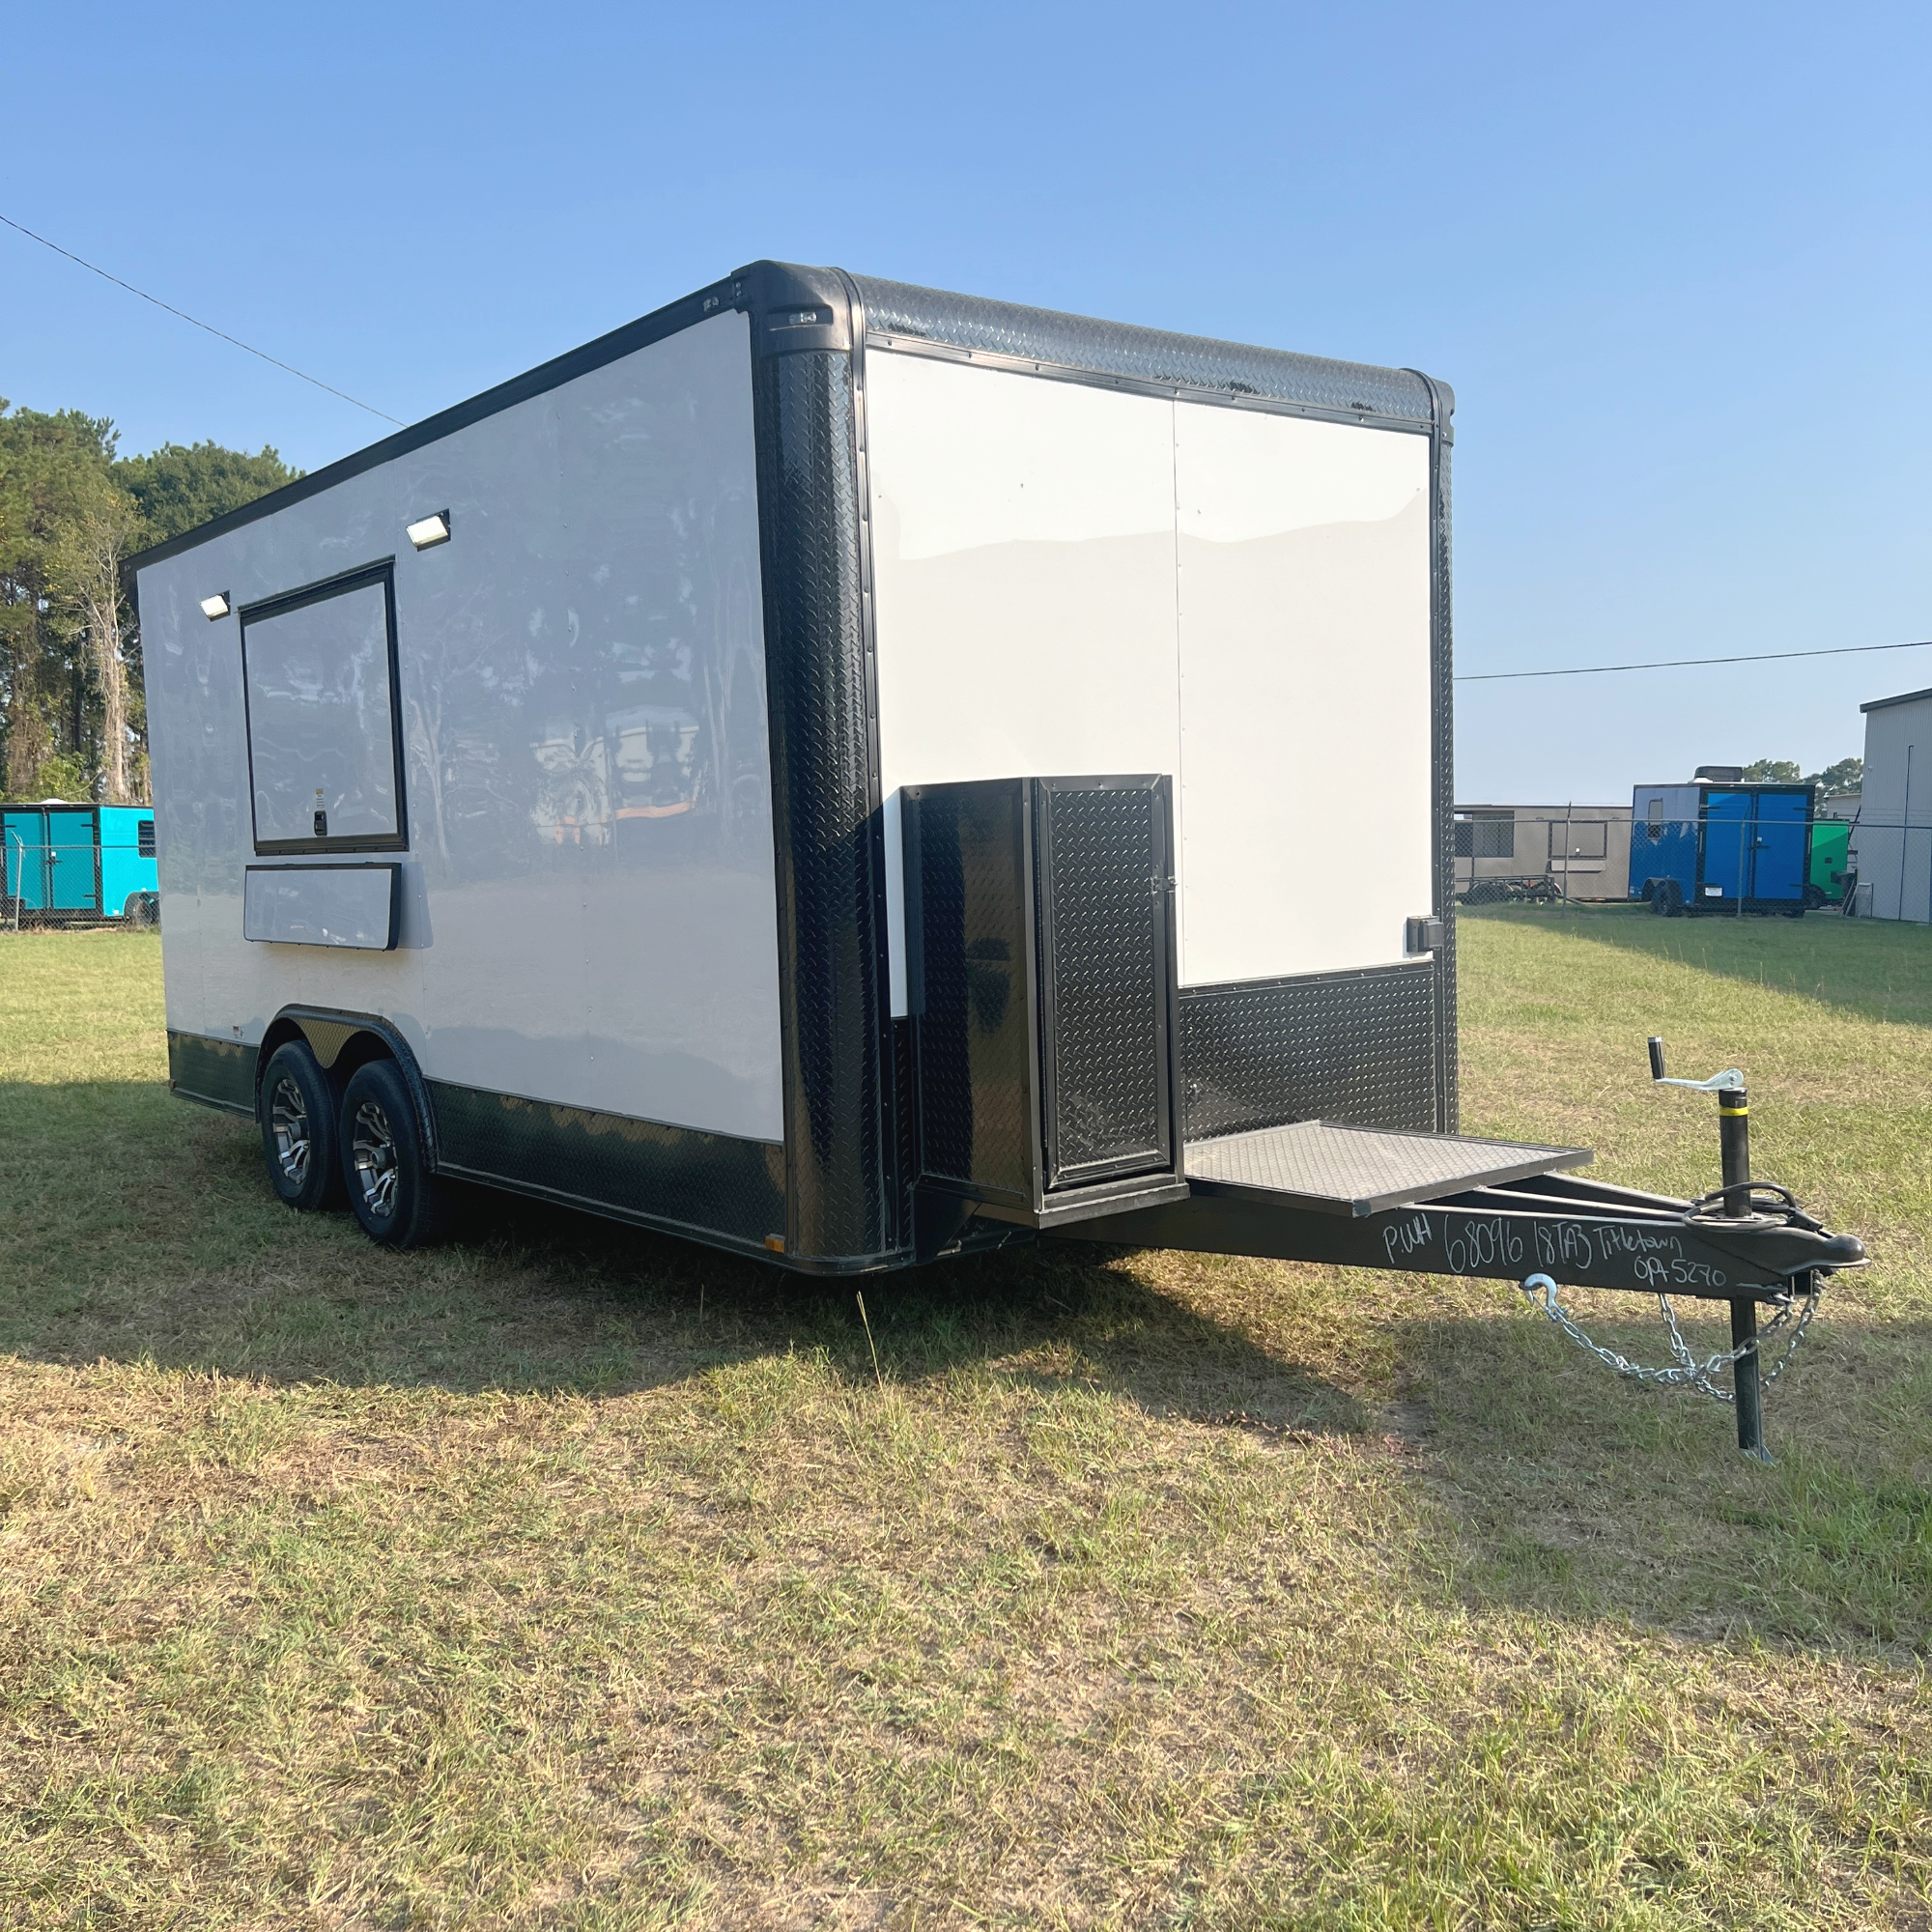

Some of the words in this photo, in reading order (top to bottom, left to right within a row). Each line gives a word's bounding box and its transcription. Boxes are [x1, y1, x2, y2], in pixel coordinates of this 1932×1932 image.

[1444, 1213, 1523, 1273] 68096
[1593, 1224, 1683, 1260] Titletown
[1670, 1258, 1727, 1288] 5270
